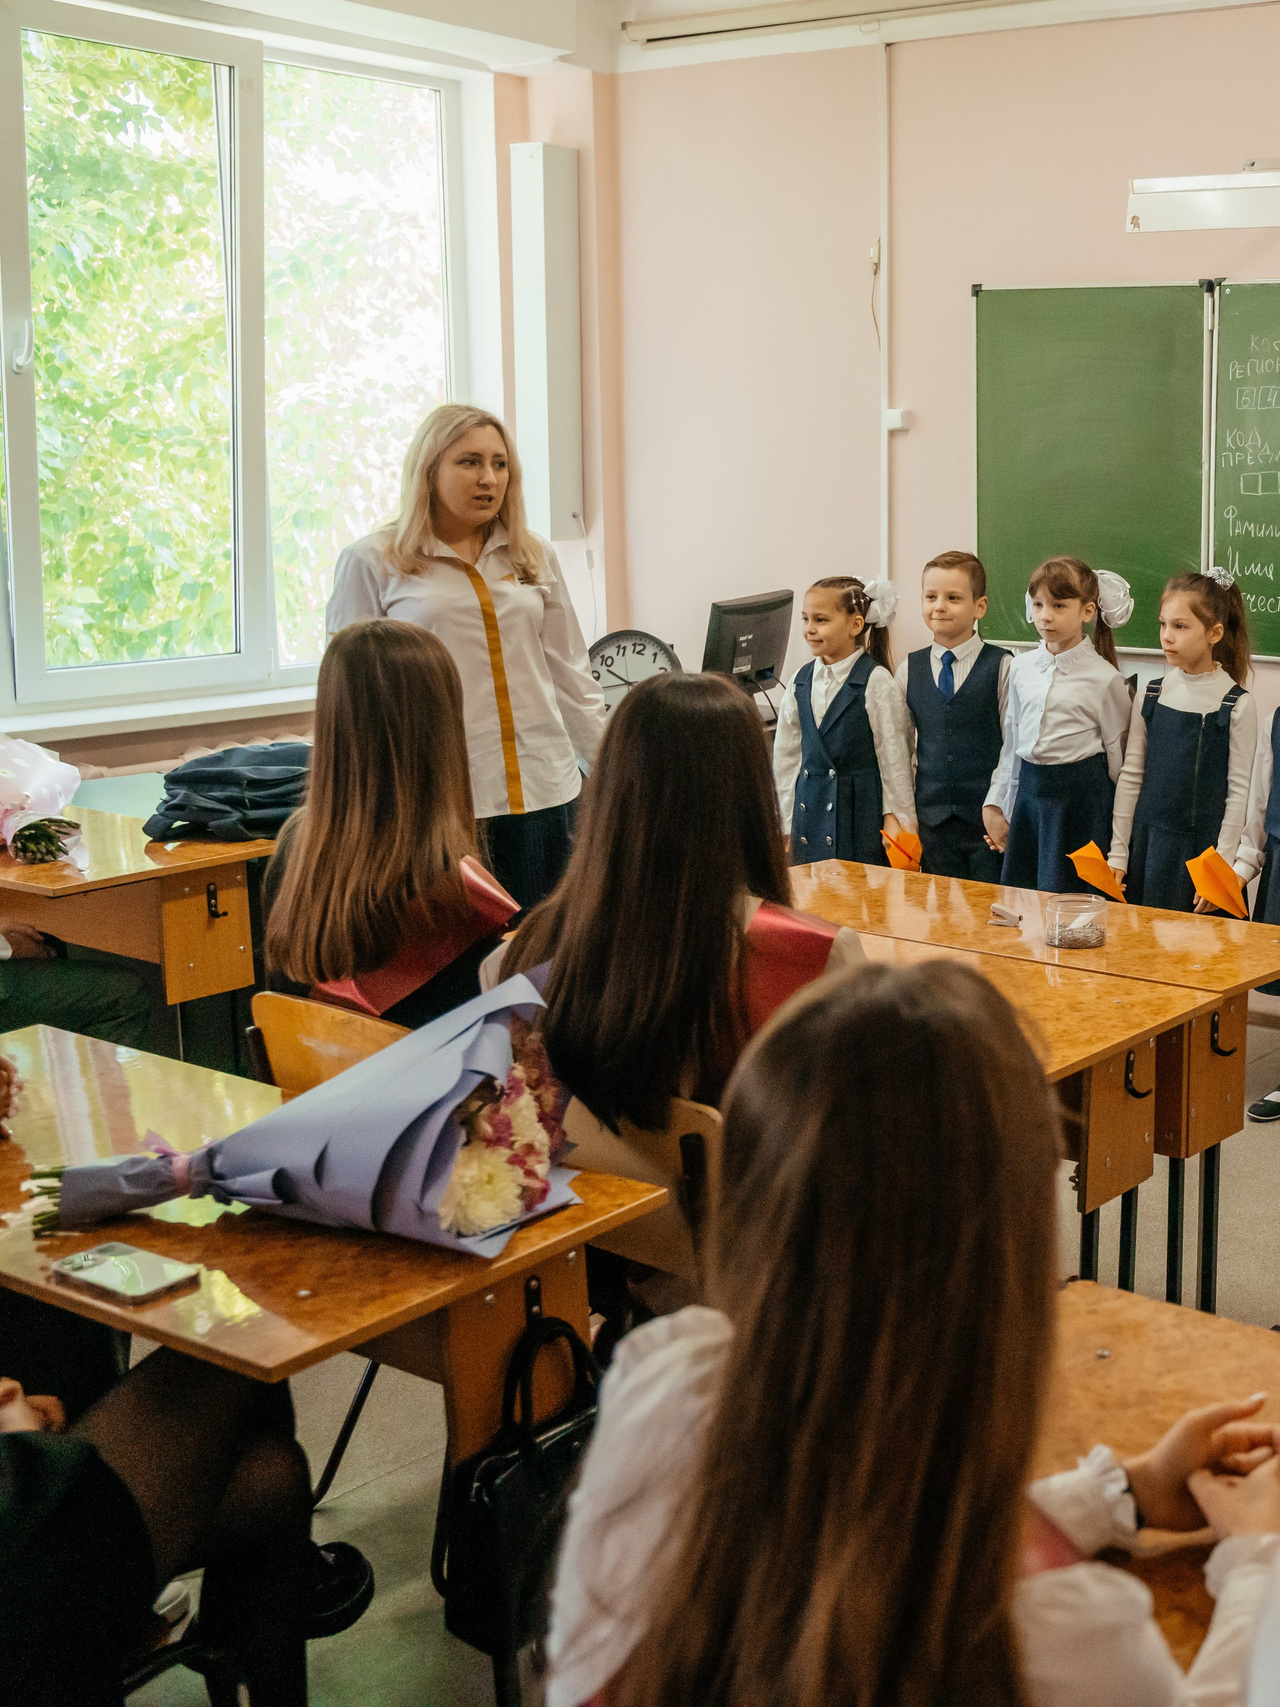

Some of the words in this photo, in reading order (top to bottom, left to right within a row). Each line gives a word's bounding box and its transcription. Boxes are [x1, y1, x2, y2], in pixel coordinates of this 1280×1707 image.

[631, 642, 647, 656] 12
[599, 654, 615, 668] 10
[652, 652, 659, 664] 1
